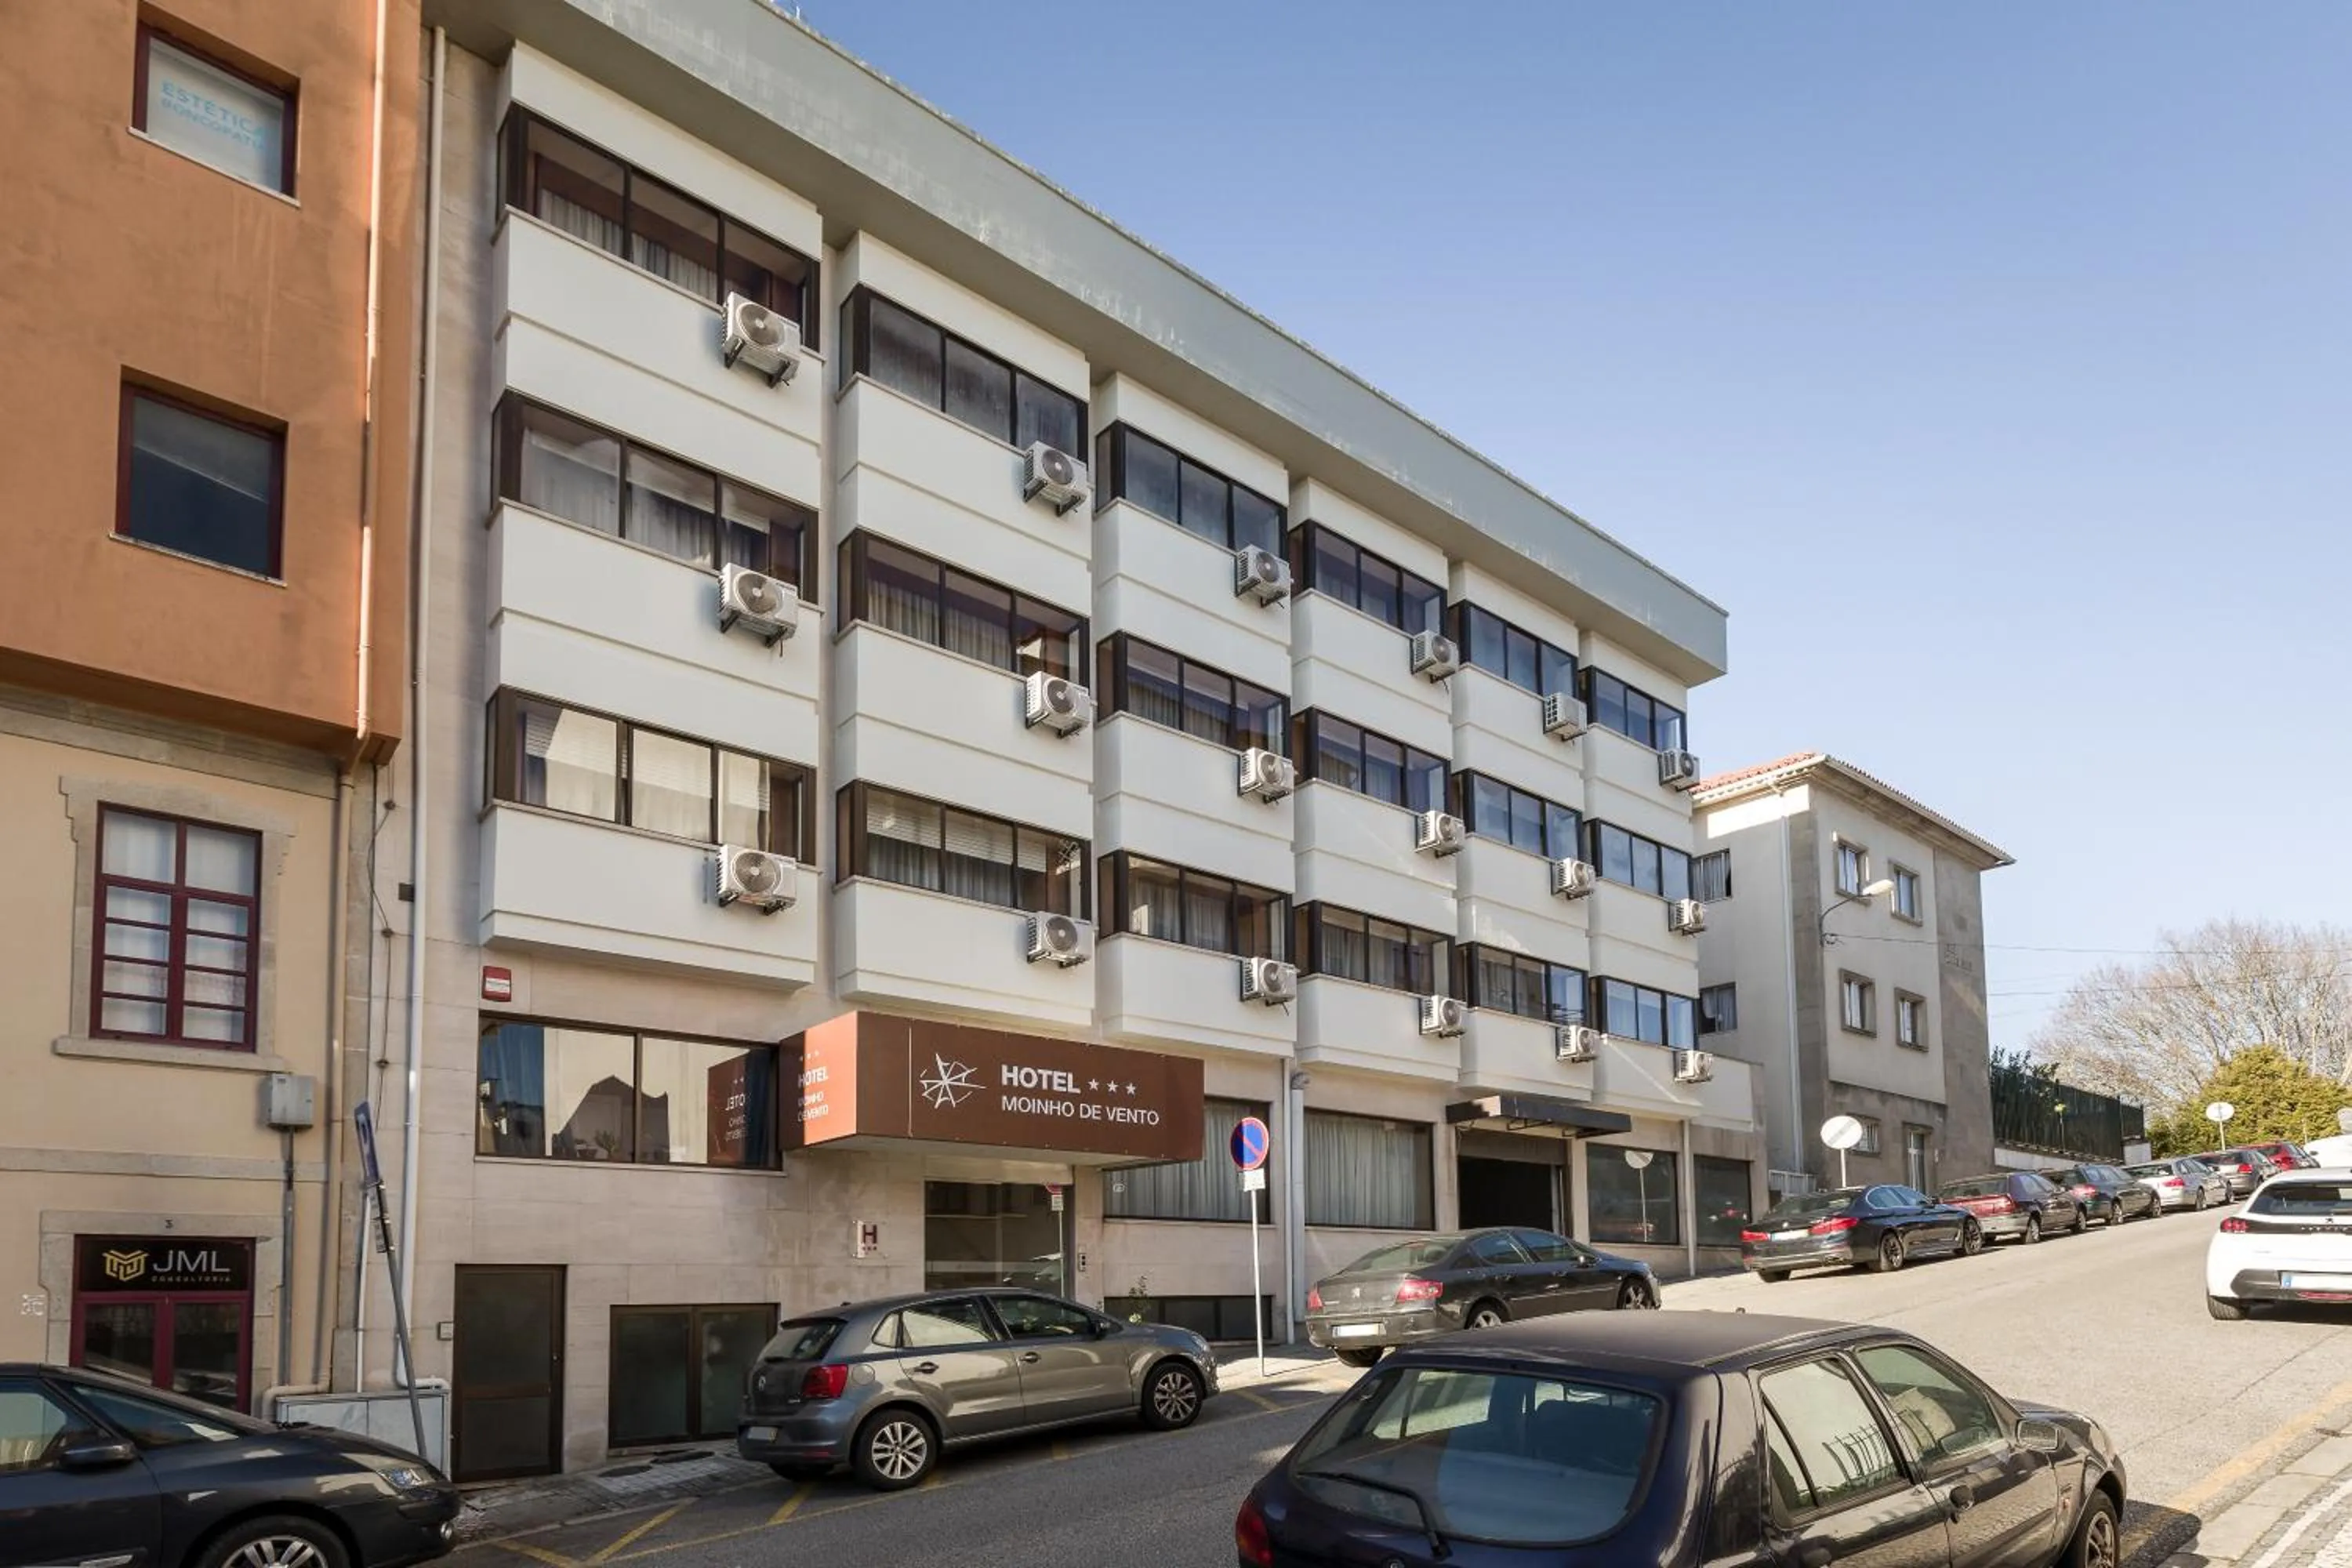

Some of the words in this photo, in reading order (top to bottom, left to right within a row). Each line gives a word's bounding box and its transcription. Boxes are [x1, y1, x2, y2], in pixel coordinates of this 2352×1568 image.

[797, 1066, 829, 1088] HOTEL
[1001, 1064, 1081, 1094] HOTEL
[1001, 1095, 1075, 1117] MOINHO
[1079, 1103, 1102, 1120] DE
[1105, 1106, 1160, 1126] VENTO
[863, 1225, 877, 1244] H
[153, 1250, 230, 1272] JML
